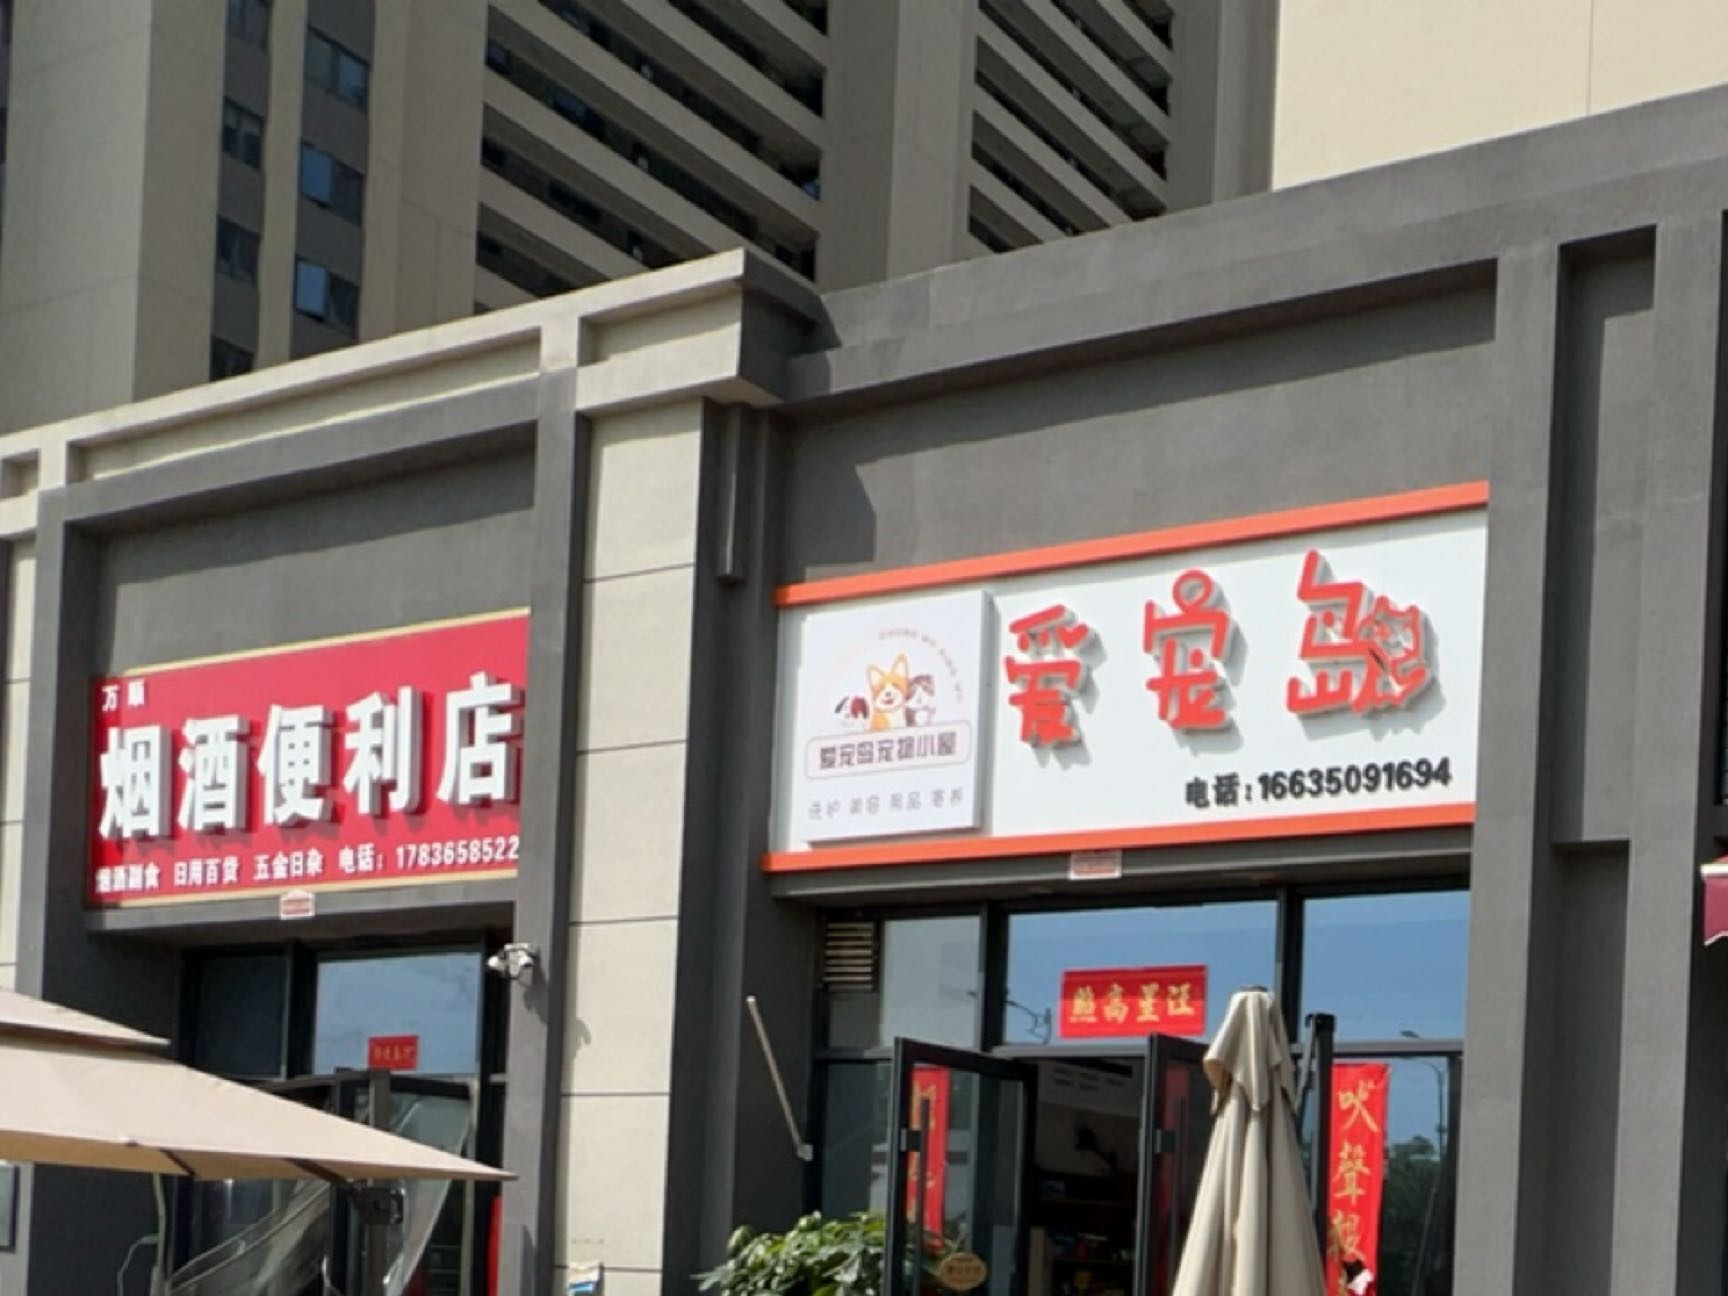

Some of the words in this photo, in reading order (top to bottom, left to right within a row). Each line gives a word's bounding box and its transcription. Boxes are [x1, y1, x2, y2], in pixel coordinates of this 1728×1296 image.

[99, 671, 518, 839] 烟酒便利店
